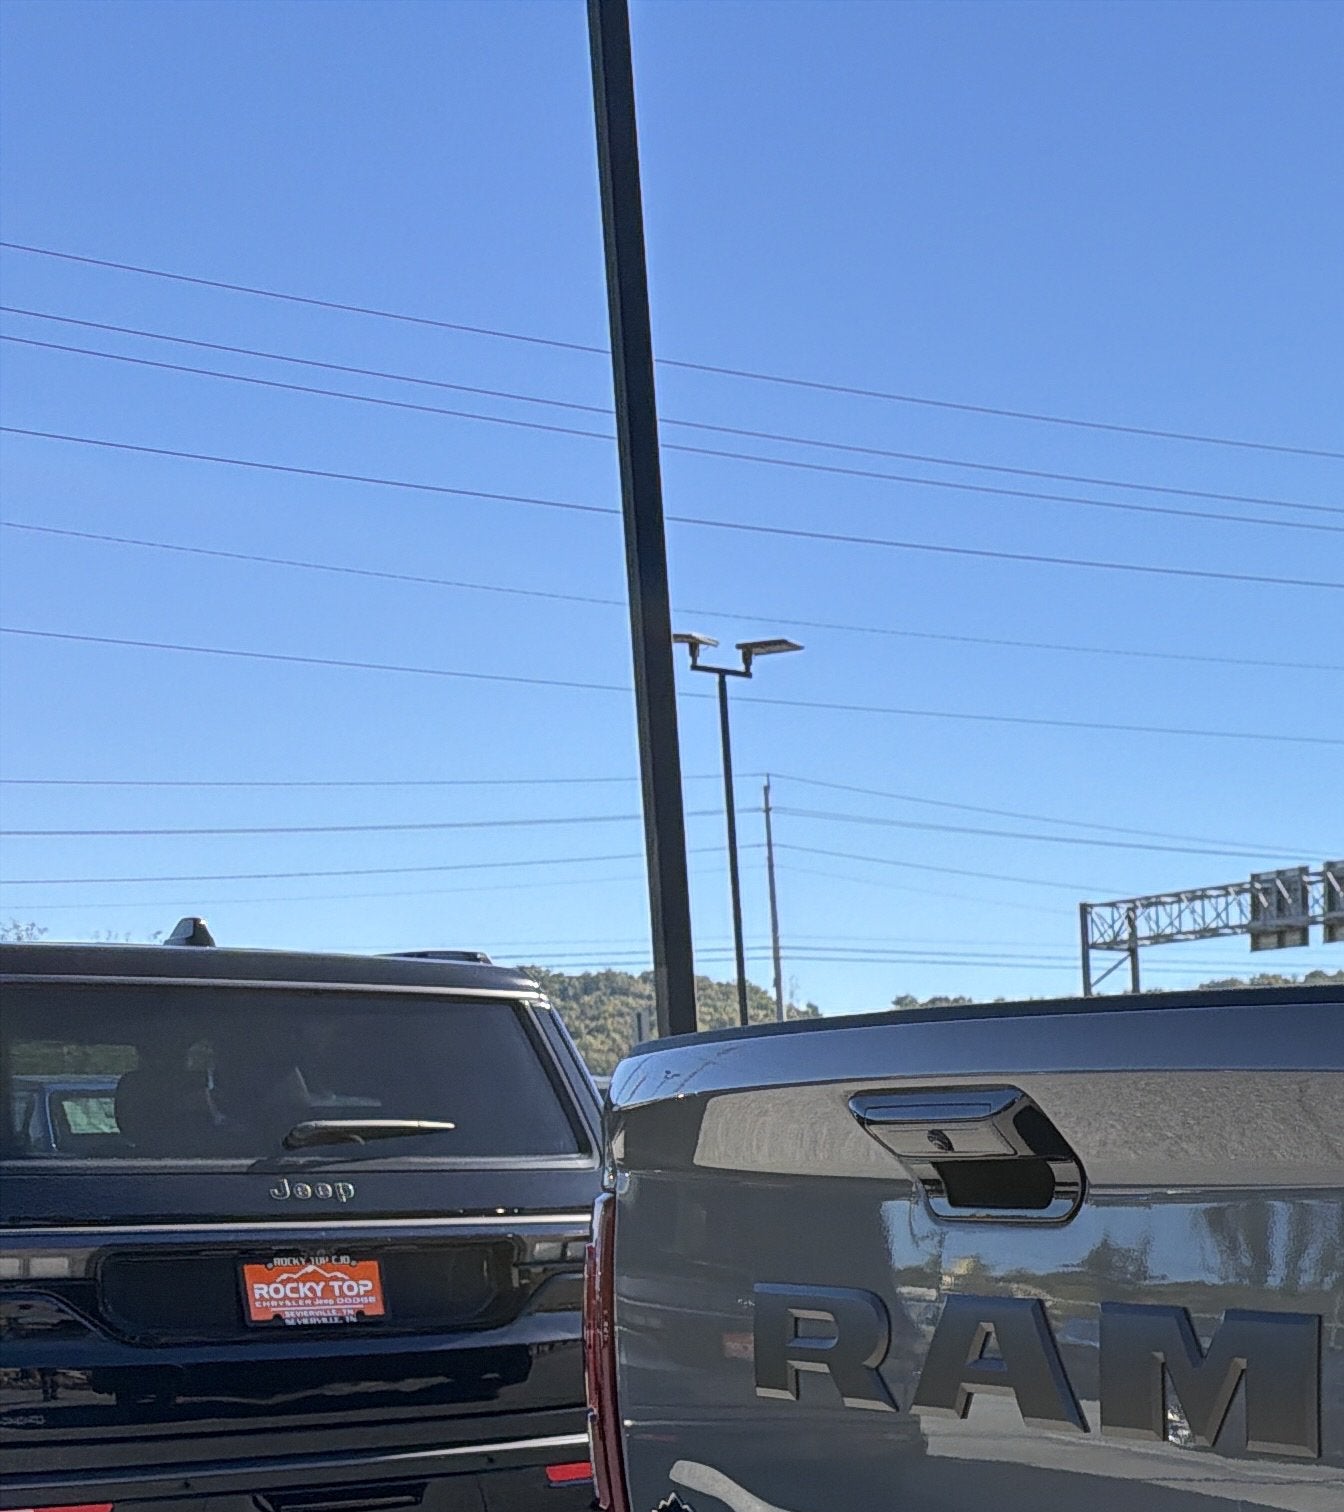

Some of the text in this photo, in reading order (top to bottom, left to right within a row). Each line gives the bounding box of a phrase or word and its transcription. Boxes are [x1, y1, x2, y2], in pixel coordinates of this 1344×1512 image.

[270, 1178, 355, 1203] Jeep
[253, 1280, 373, 1299] ROCKY TOP
[255, 1300, 312, 1308] CHRYSLER
[336, 1296, 377, 1304] DODGE
[753, 1282, 1322, 1458] RAM
